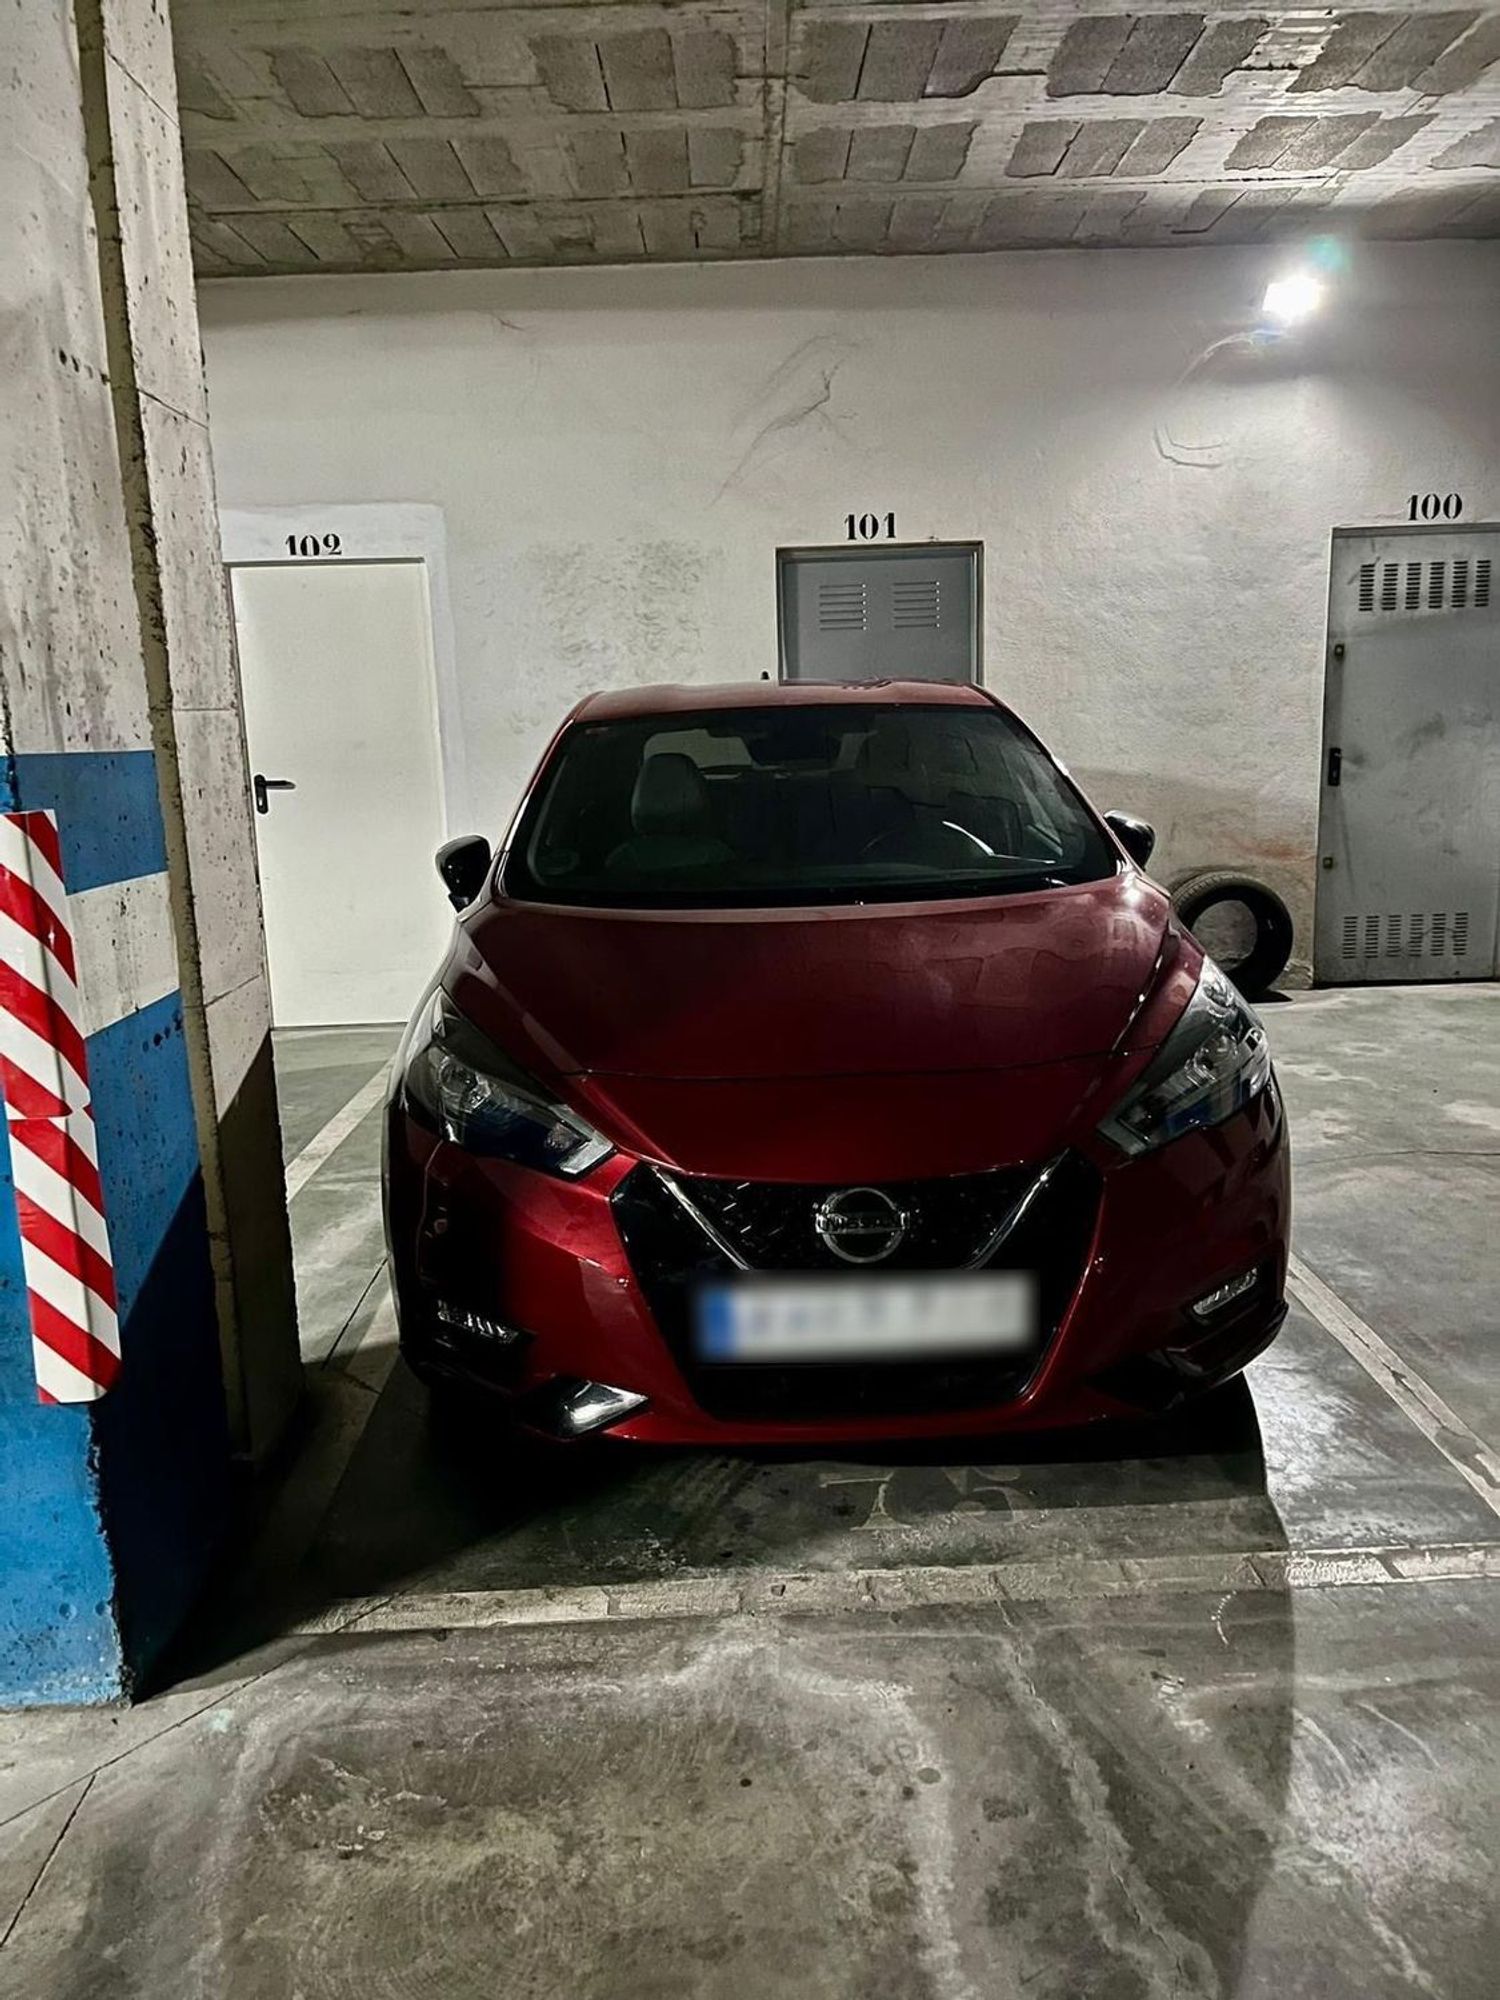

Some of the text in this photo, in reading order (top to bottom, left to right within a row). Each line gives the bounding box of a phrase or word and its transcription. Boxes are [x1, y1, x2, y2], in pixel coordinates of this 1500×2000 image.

[1406, 493, 1462, 521] 100
[844, 512, 896, 540] 101
[285, 533, 342, 556] 102
